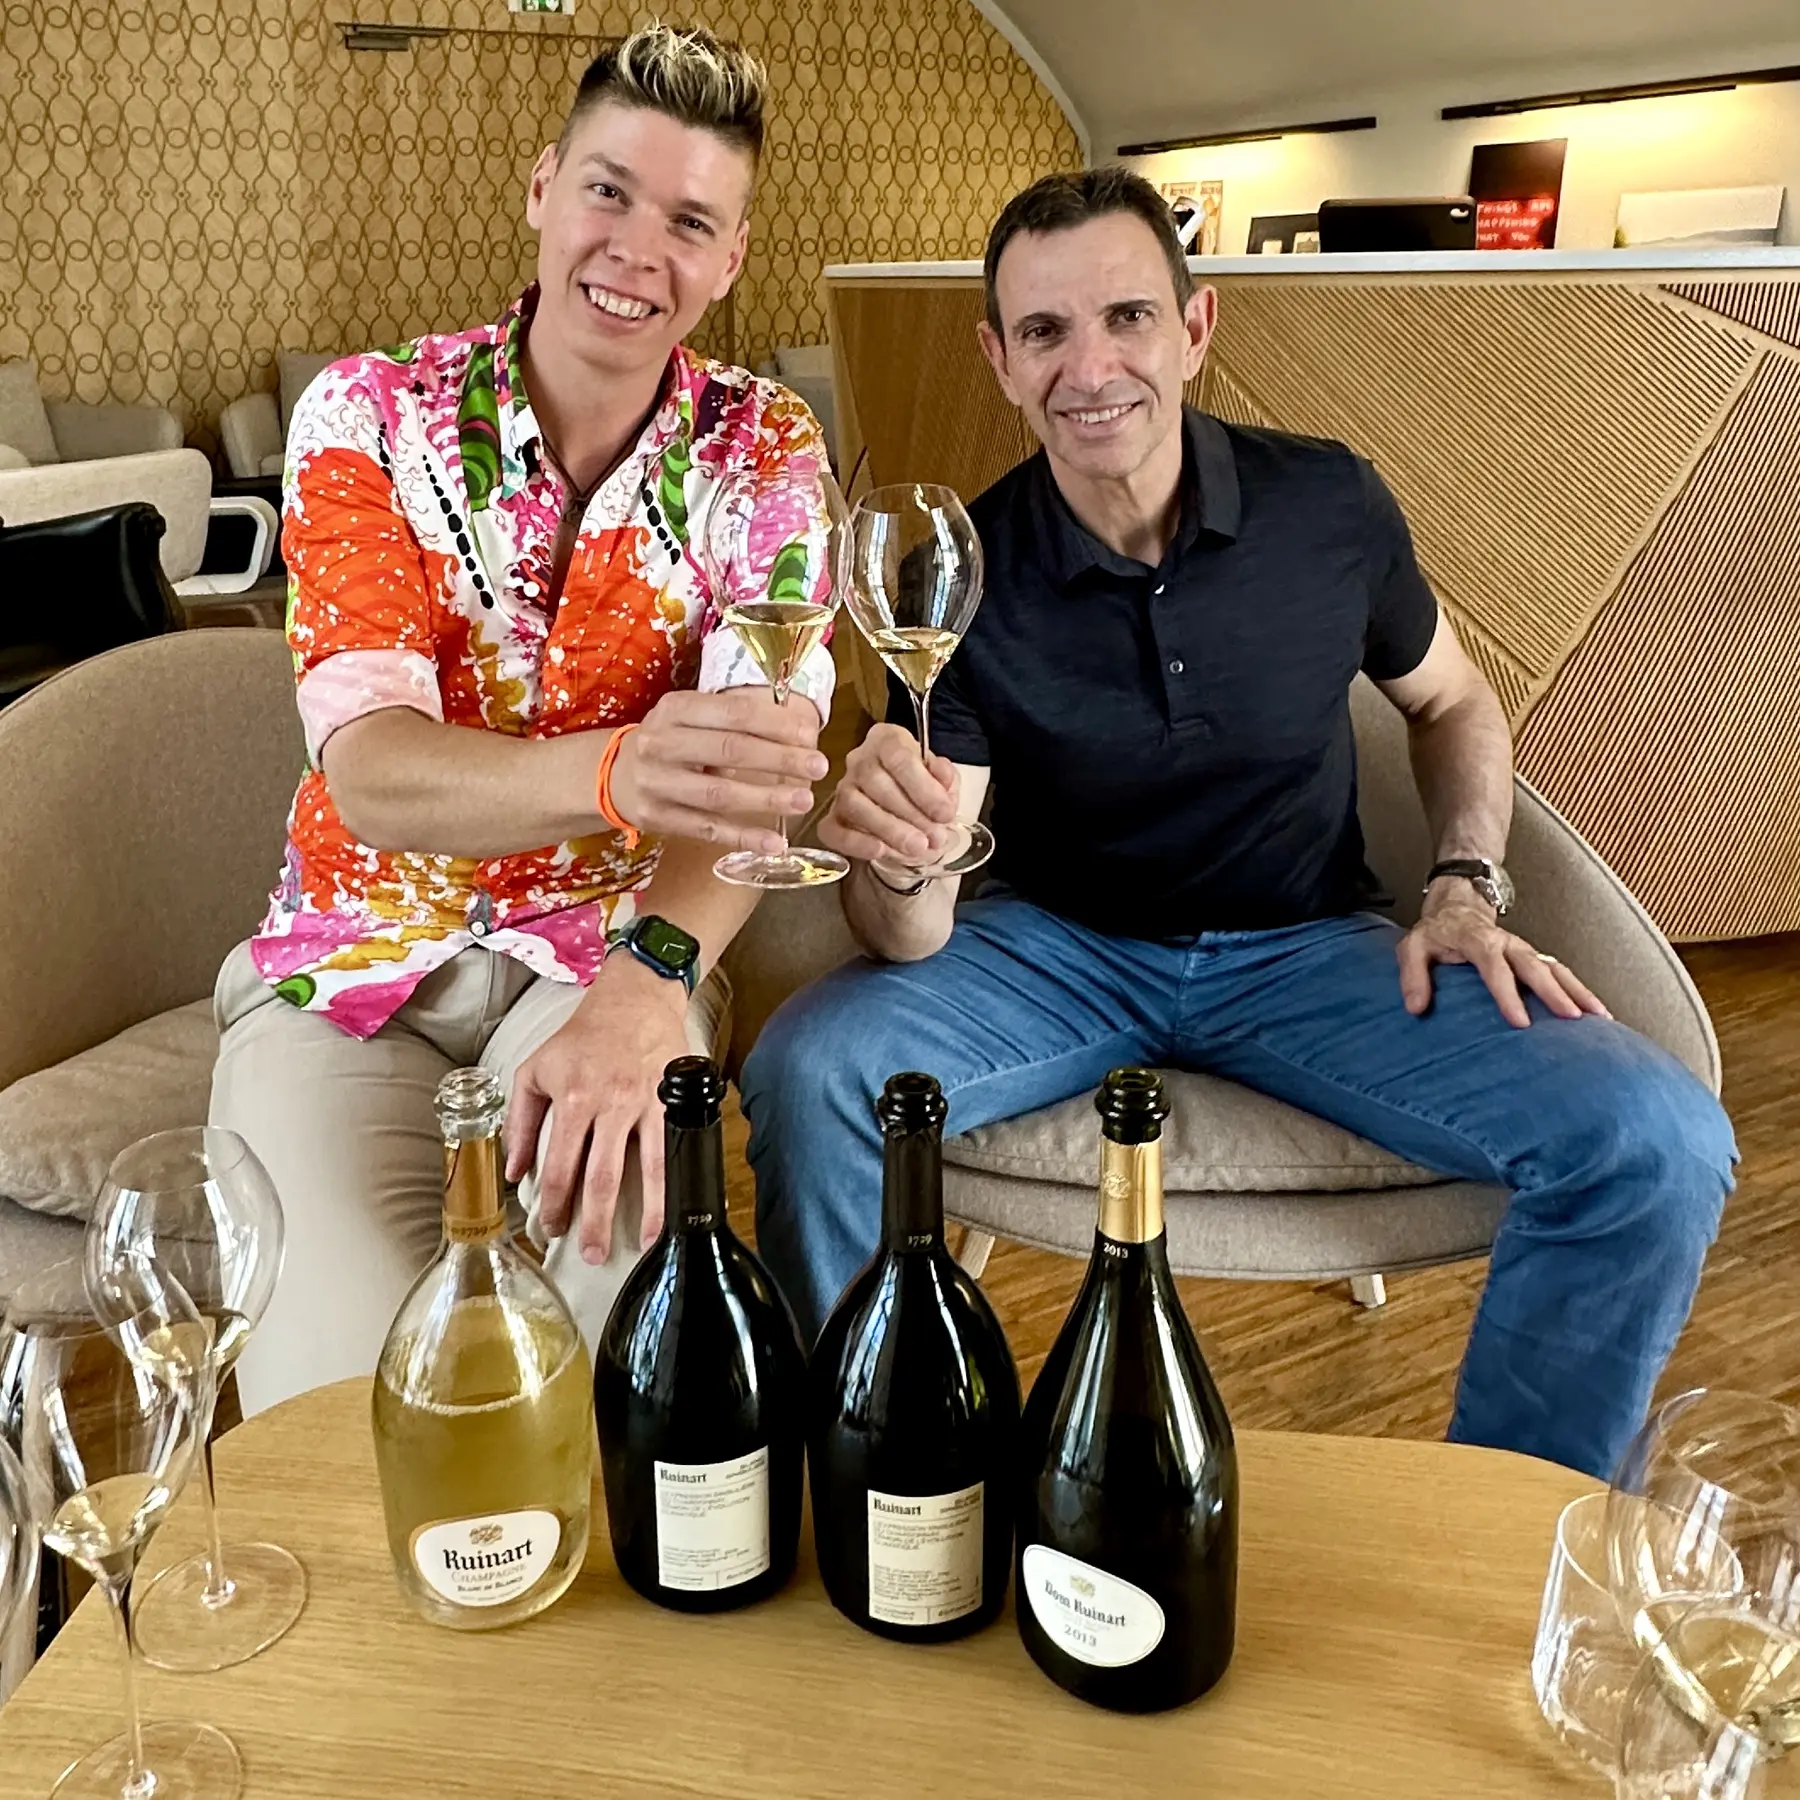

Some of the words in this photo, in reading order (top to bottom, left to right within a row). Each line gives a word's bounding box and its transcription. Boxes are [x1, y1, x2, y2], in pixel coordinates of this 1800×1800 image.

[687, 1213, 712, 1226] 1729
[907, 1234, 932, 1247] 1729
[1104, 1242, 1128, 1258] 2013
[660, 1468, 706, 1483] Ruinart
[874, 1498, 921, 1515] Ruinart
[443, 1538, 533, 1570] Ruinart
[451, 1563, 527, 1584] CHAMPAGNE
[1045, 1579, 1071, 1608] Dom
[1074, 1598, 1126, 1627] Ruinart
[1064, 1623, 1097, 1647] 2013
